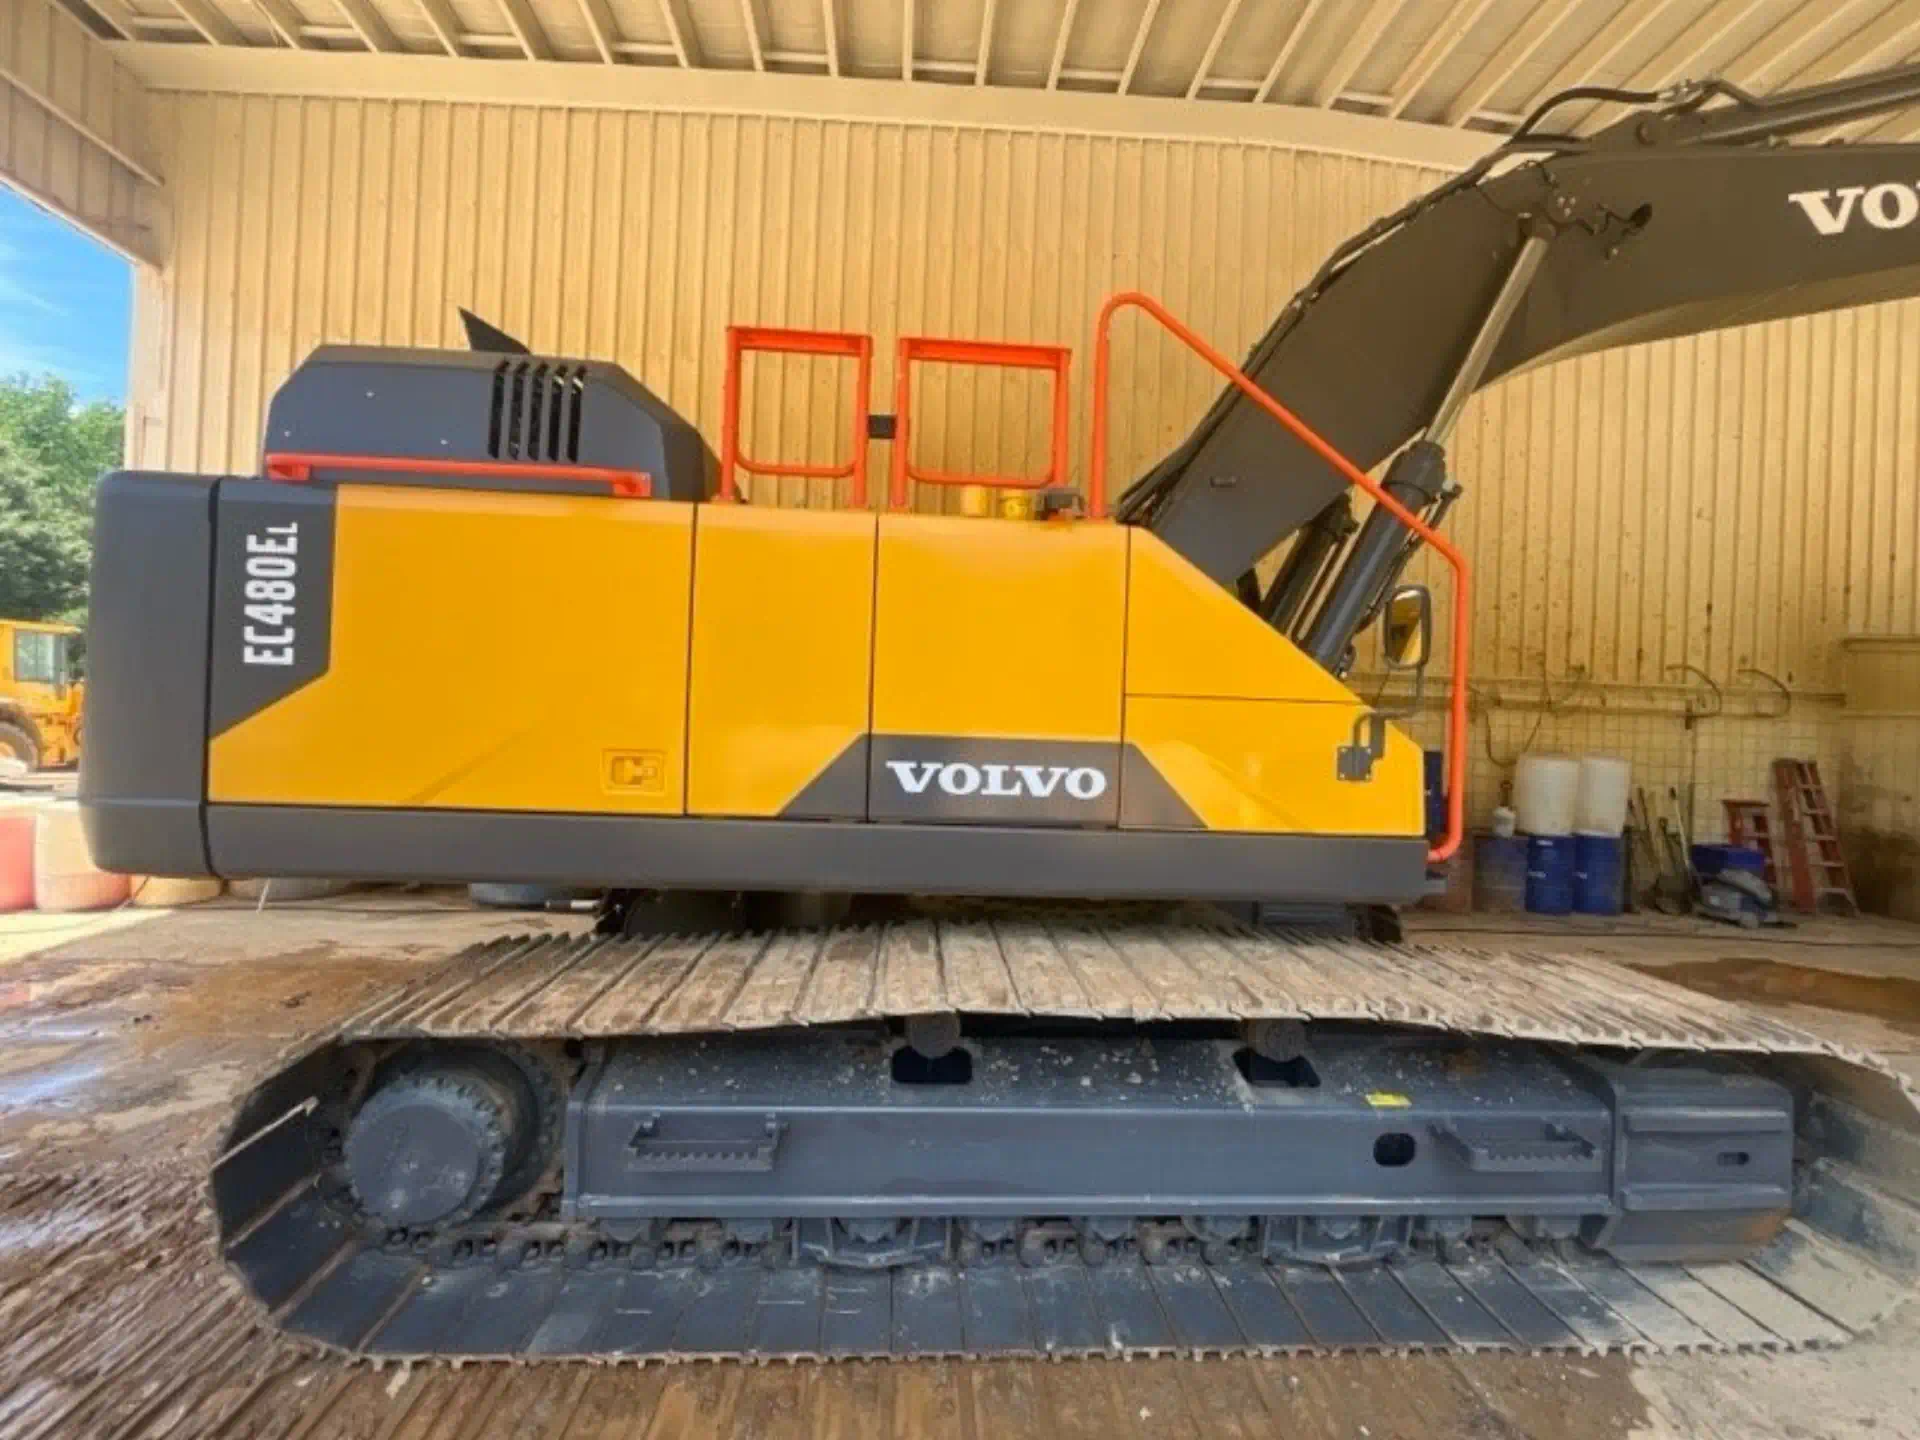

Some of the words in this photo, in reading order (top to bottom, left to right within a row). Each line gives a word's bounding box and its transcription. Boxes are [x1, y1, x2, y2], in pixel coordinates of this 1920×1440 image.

[1788, 180, 1920, 235] VO
[243, 522, 298, 666] EC480EL
[885, 760, 1108, 800] VOLVO
